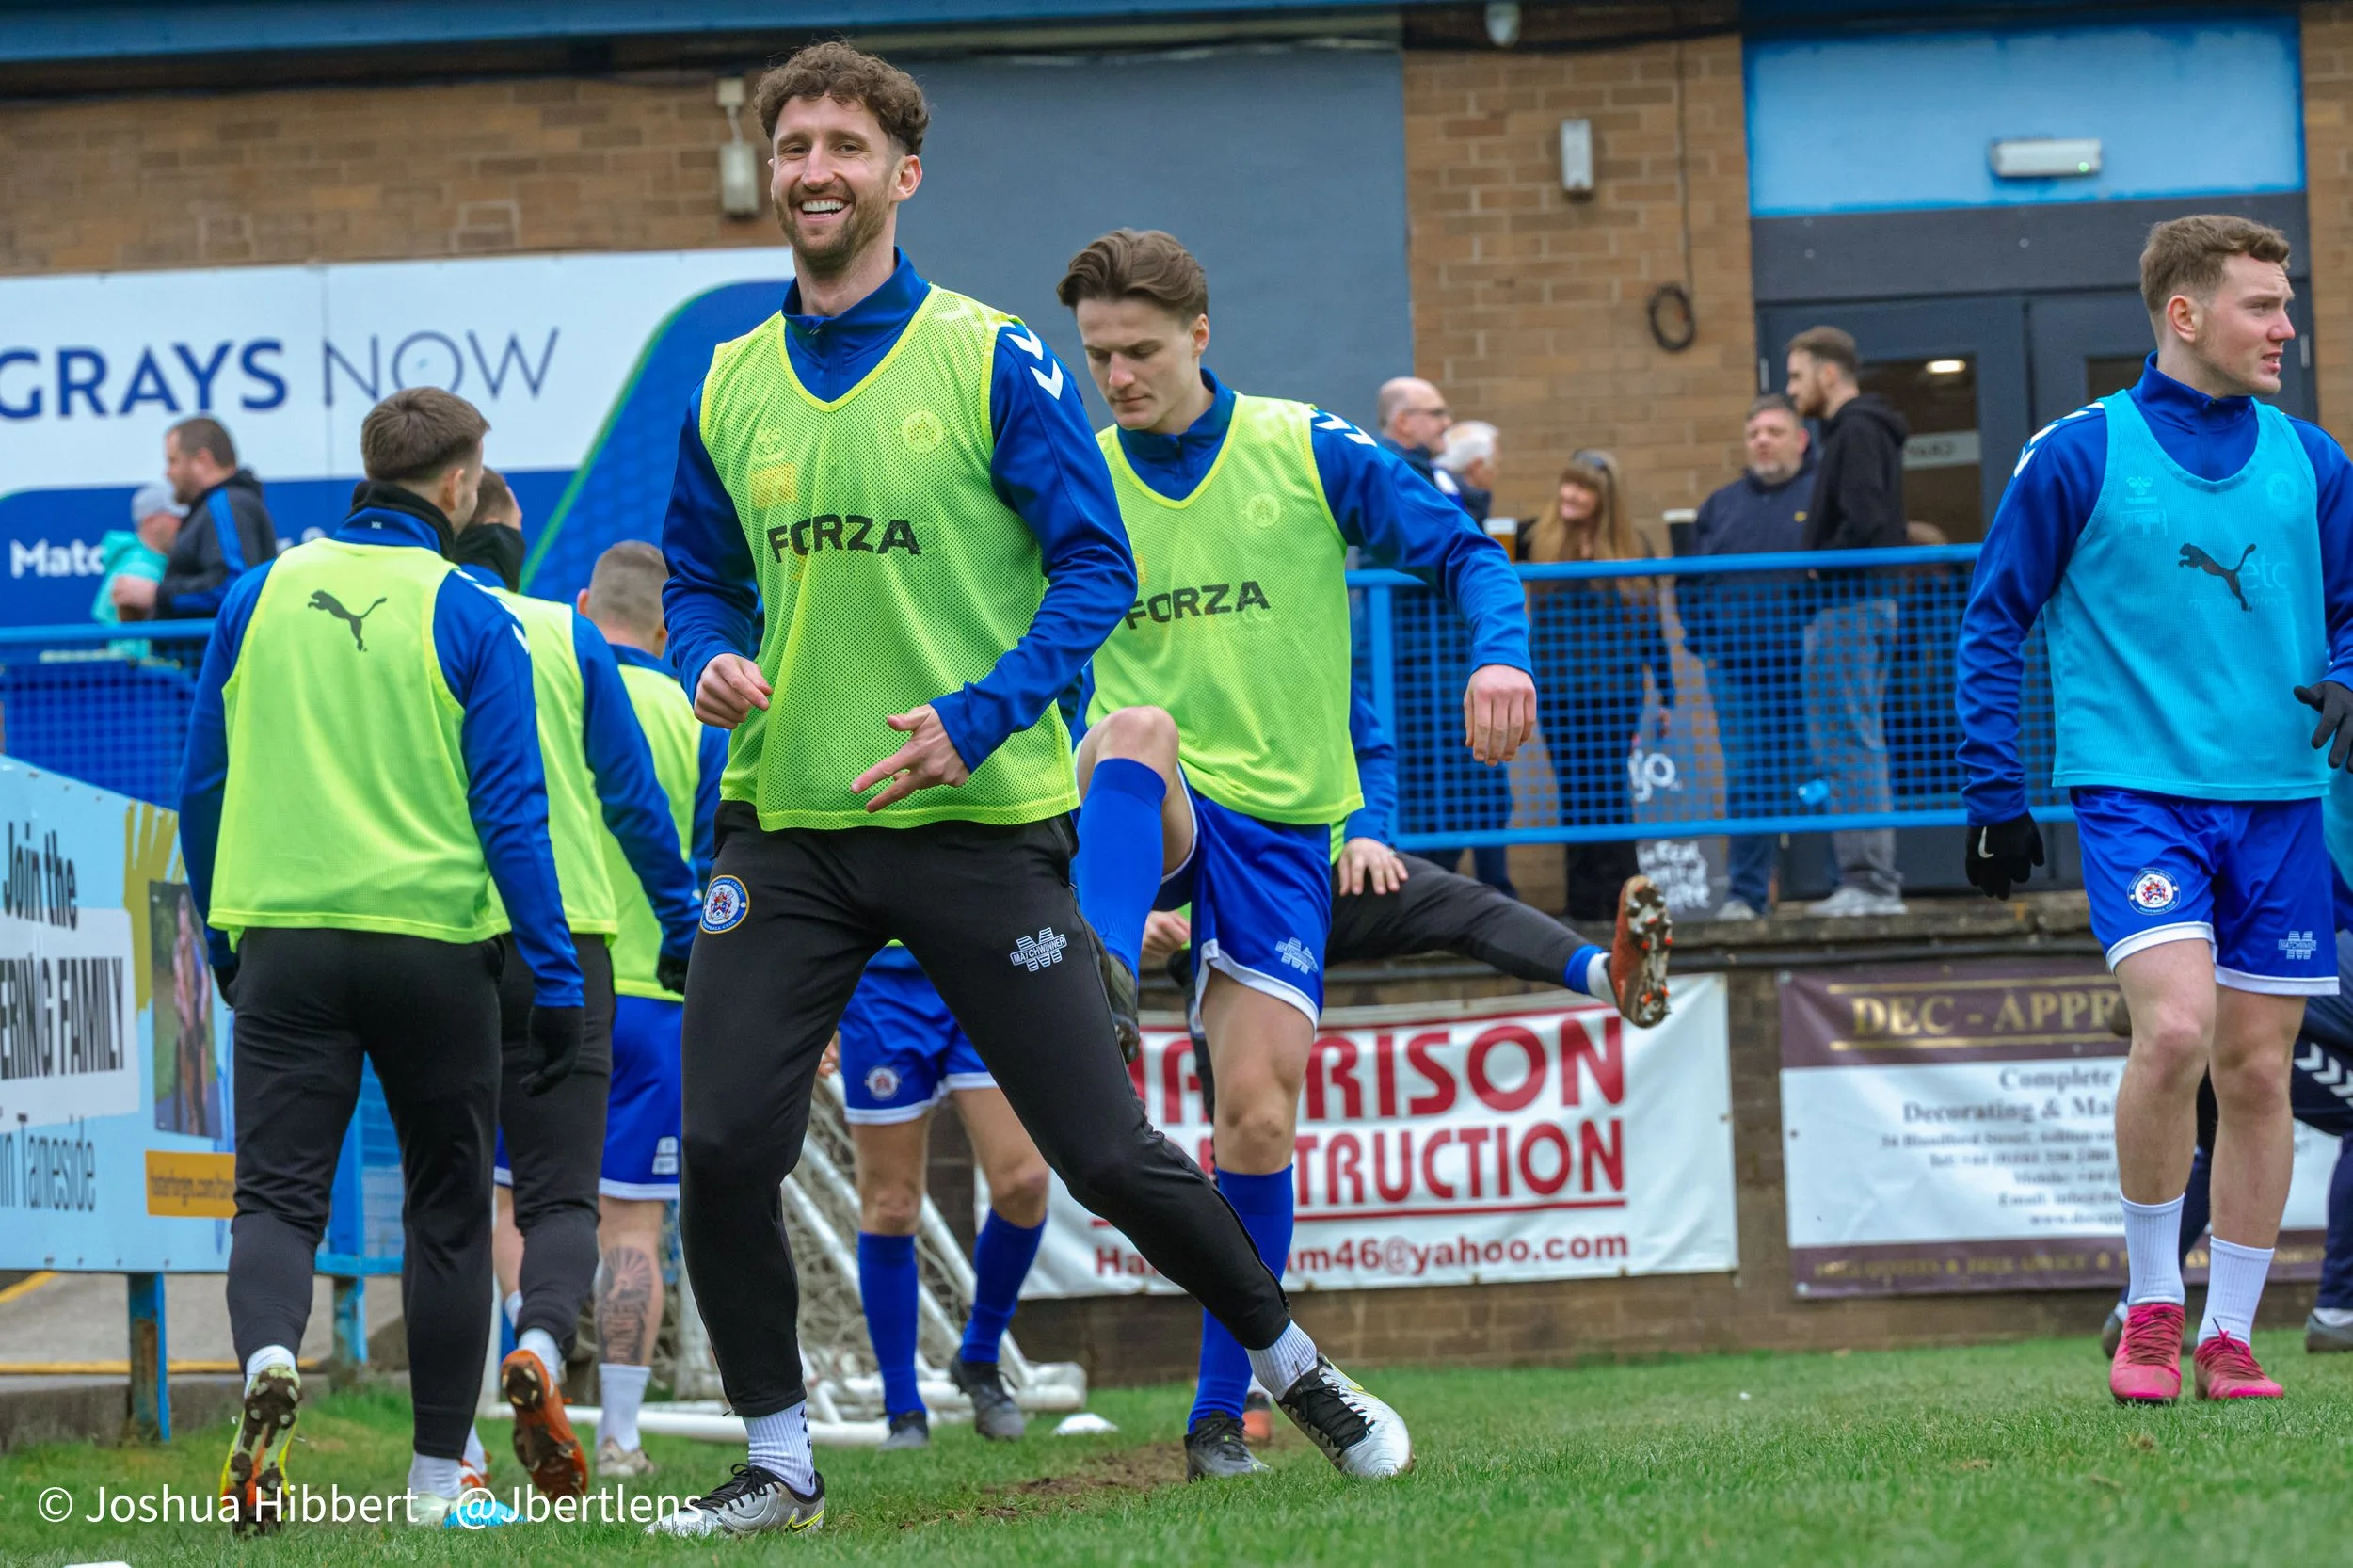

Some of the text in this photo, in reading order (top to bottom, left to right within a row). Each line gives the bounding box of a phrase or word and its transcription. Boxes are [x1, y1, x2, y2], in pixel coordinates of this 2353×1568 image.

[0, 327, 559, 421] GRAYS NOW
[766, 513, 922, 564] FORZA
[1124, 580, 1271, 630] FORZA
[3, 821, 78, 931] Join the
[1012, 936, 1065, 964] MATCHWINNER
[58, 956, 124, 1075] FAMILY
[1851, 994, 1955, 1036] DEC
[1998, 1064, 2114, 1093] Complete
[1902, 1098, 2037, 1125] Decorating
[2041, 1098, 2060, 1118] &
[17, 1112, 97, 1212] Tameside
